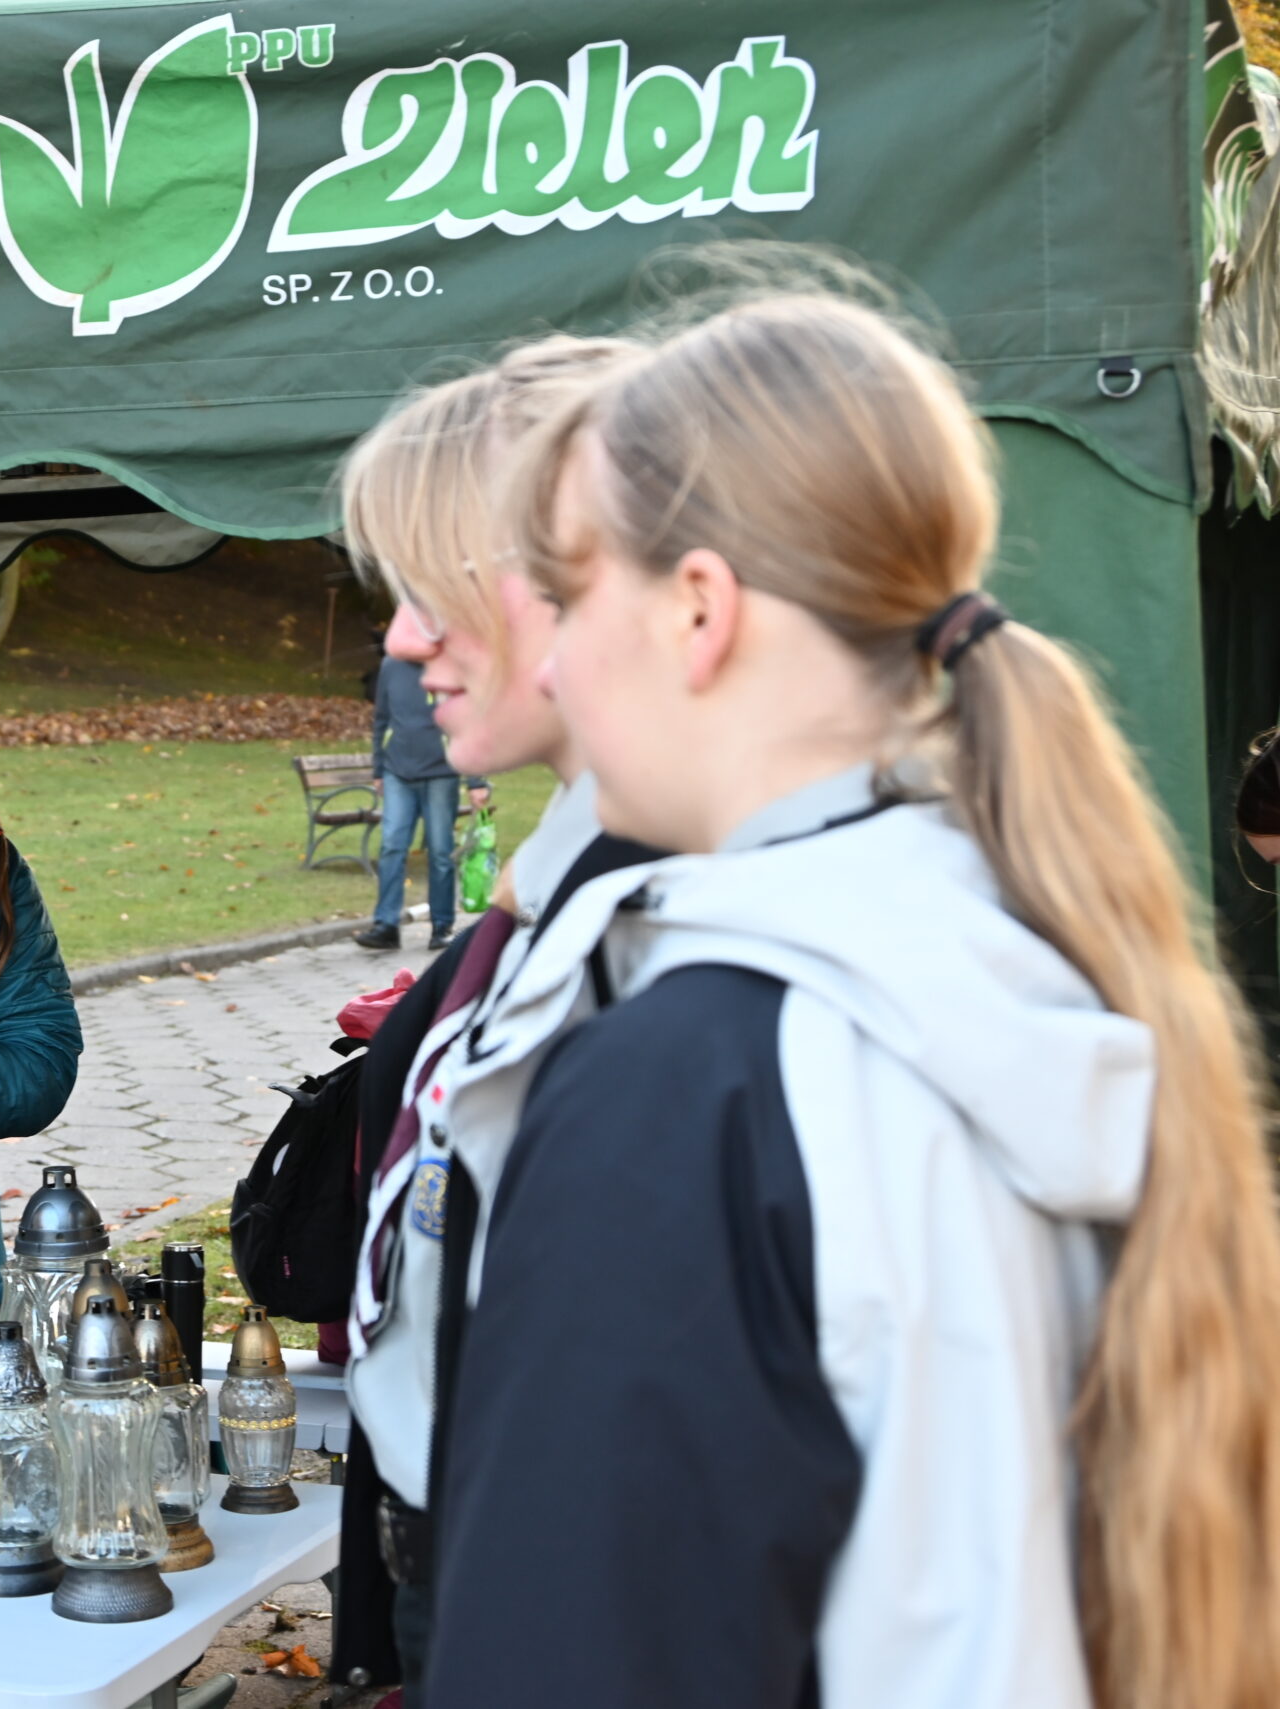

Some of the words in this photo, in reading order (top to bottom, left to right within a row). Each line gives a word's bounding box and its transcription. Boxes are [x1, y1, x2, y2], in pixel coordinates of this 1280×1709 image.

[227, 23, 336, 76] PPU
[262, 273, 320, 306] SP.
[329, 270, 355, 302] Z
[363, 265, 444, 300] O.O.
